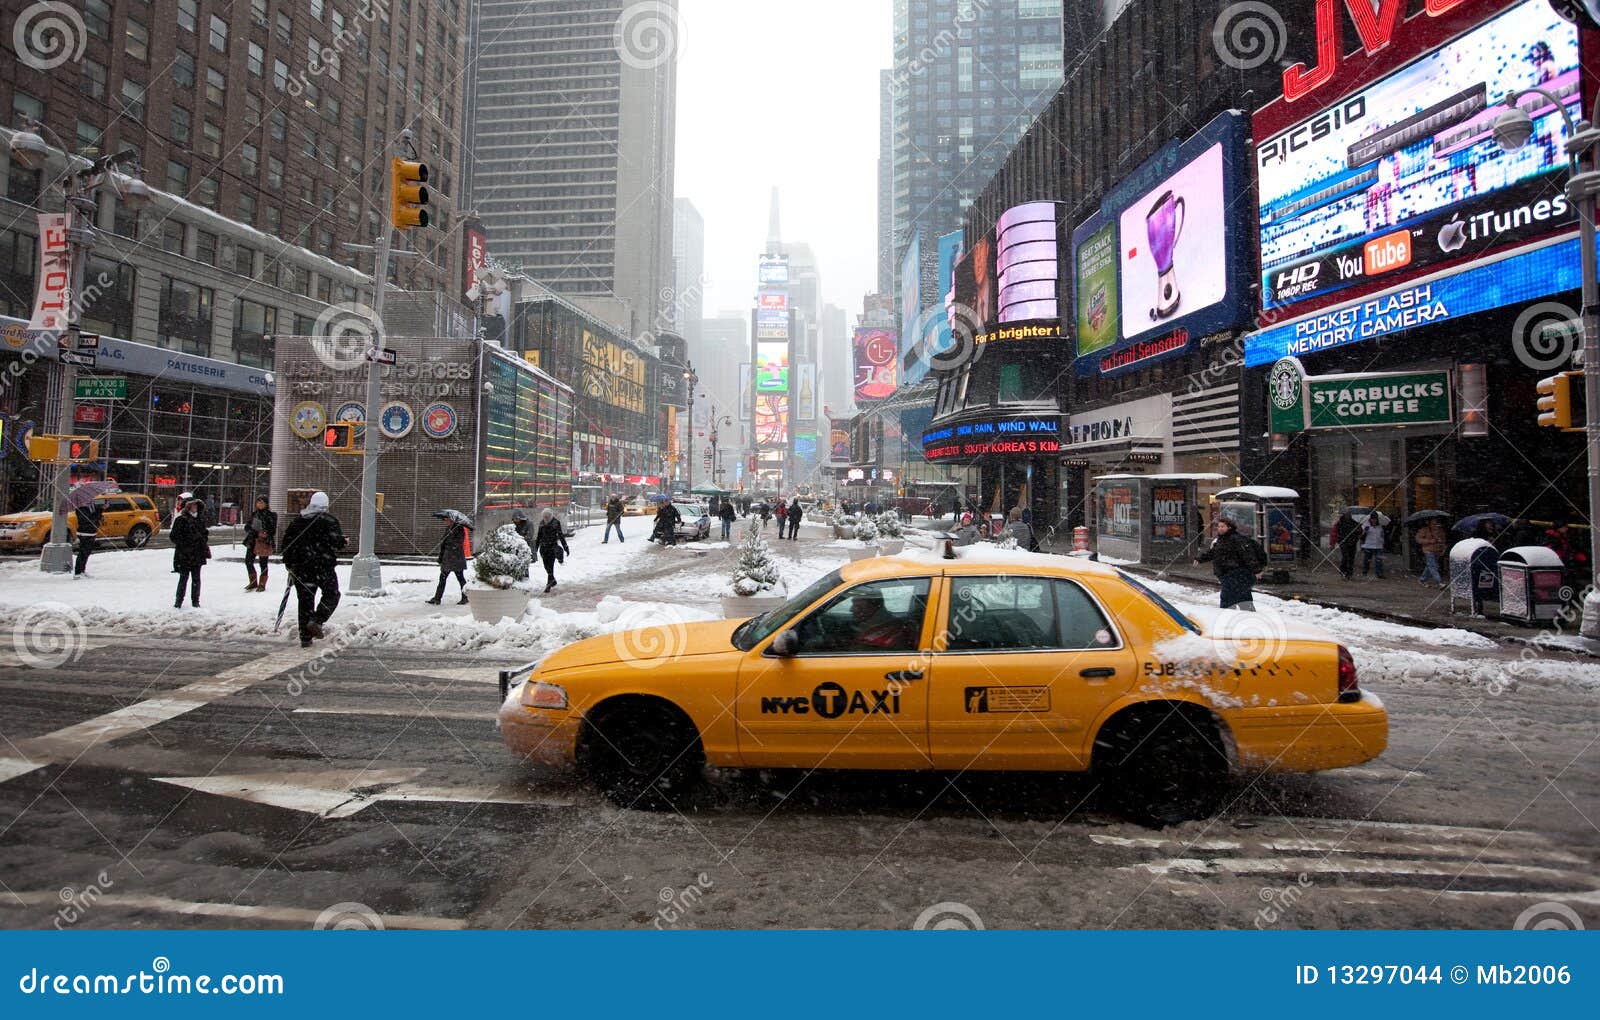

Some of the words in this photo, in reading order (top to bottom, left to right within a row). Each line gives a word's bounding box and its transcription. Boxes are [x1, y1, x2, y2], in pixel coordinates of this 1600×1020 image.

[1283, 0, 1474, 103] JV
[1262, 96, 1366, 168] PICSIO
[1470, 193, 1567, 241] iTunes
[1276, 261, 1321, 290] HD
[1301, 279, 1319, 293] REC
[1296, 305, 1361, 337] POCKET
[1364, 285, 1431, 318] FLASH
[975, 332, 989, 345] For
[999, 327, 1053, 342] brighter
[1288, 324, 1354, 356] MEMORY
[1361, 300, 1448, 337] CAMERA
[167, 359, 226, 379] PATISSERIE
[392, 362, 472, 379] FORCES
[867, 371, 893, 385] LG
[94, 388, 105, 396] 43
[107, 388, 117, 397] ST
[1314, 381, 1444, 404] STARBUCKS
[1336, 399, 1419, 417] COFFEE
[998, 421, 1026, 433] WIND
[1029, 420, 1057, 431] WALL
[1063, 416, 1134, 444] SEPHORA
[964, 443, 989, 454] SOUTH
[991, 441, 1037, 453] KOREA'S
[1040, 441, 1059, 452] KIM
[1113, 503, 1132, 524] NOT
[1154, 500, 1185, 516] NOT
[761, 696, 810, 715] NYC
[814, 684, 901, 717] TAXI
